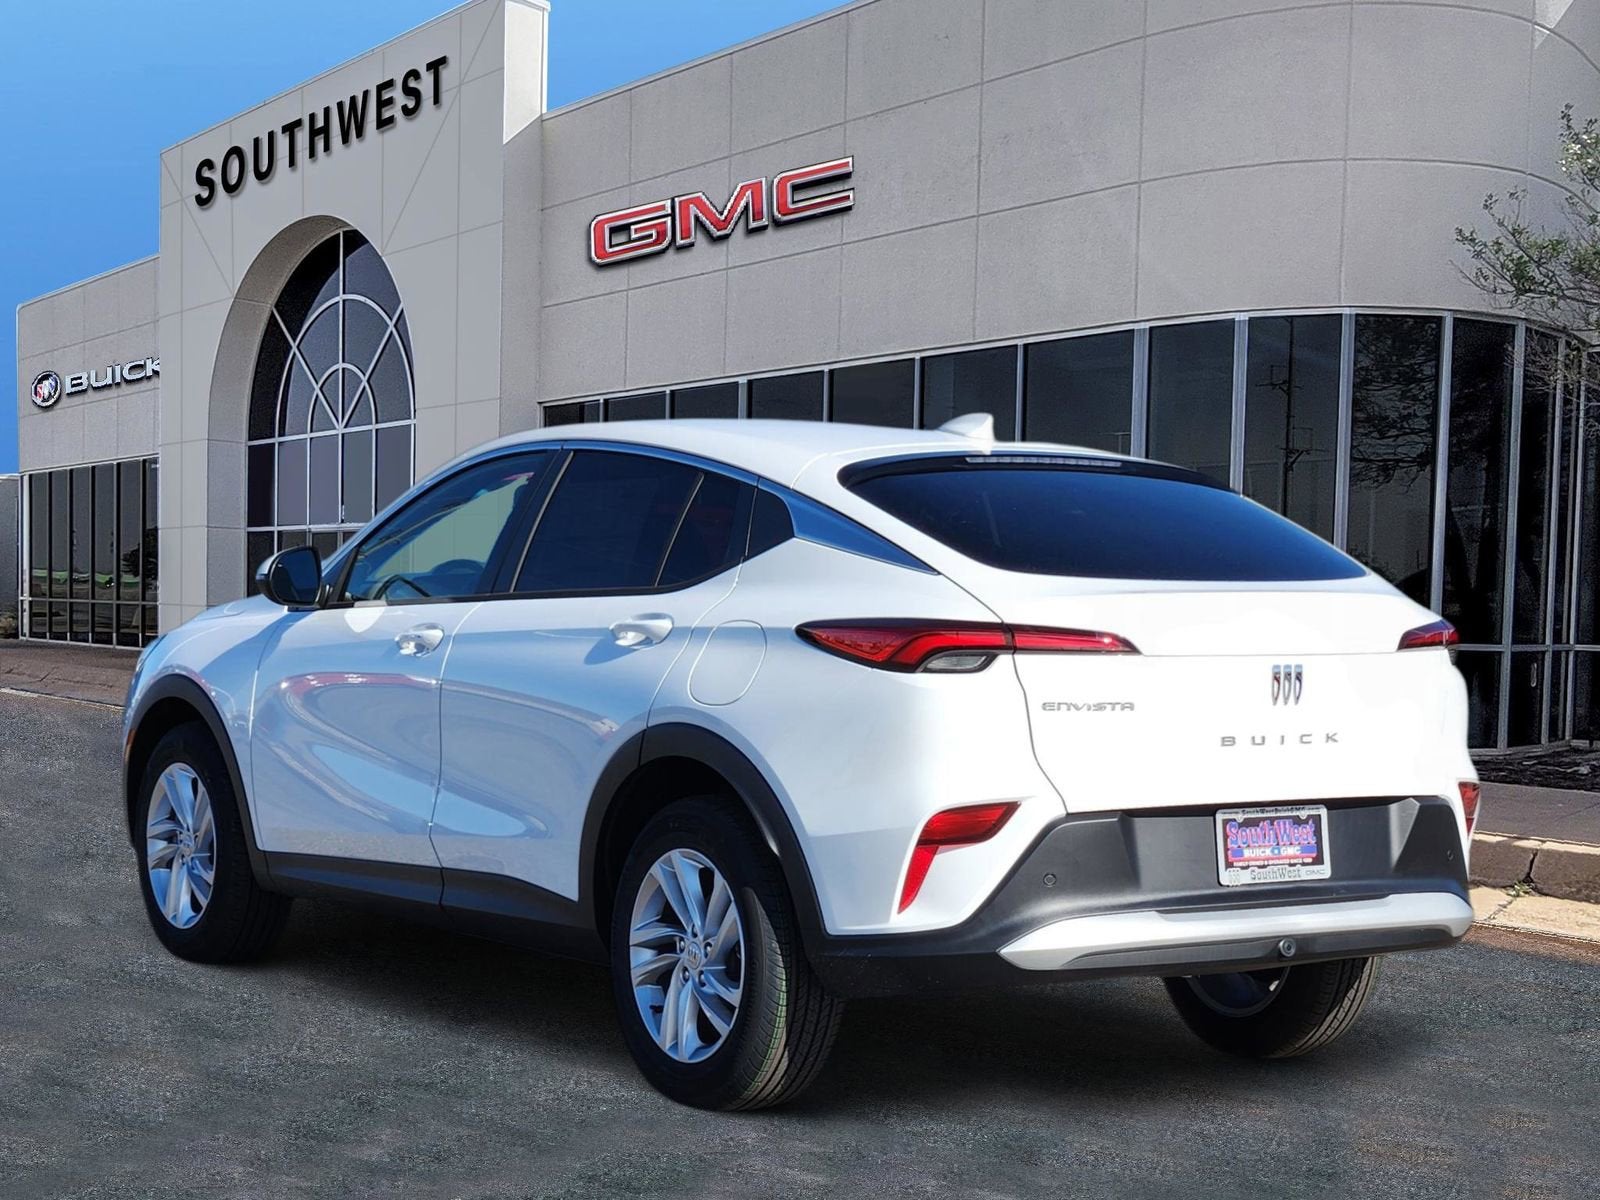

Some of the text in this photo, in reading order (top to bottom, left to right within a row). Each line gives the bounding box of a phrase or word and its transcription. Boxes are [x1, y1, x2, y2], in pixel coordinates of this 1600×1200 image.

[195, 55, 447, 207] SOUTHWEST
[590, 155, 854, 265] GMC
[65, 357, 159, 395] BUICK
[1041, 702, 1135, 712] ENVISTA
[1220, 732, 1339, 747] BUICK
[1244, 845, 1301, 857] BUICK GMC
[1250, 866, 1301, 880] SouthWest
